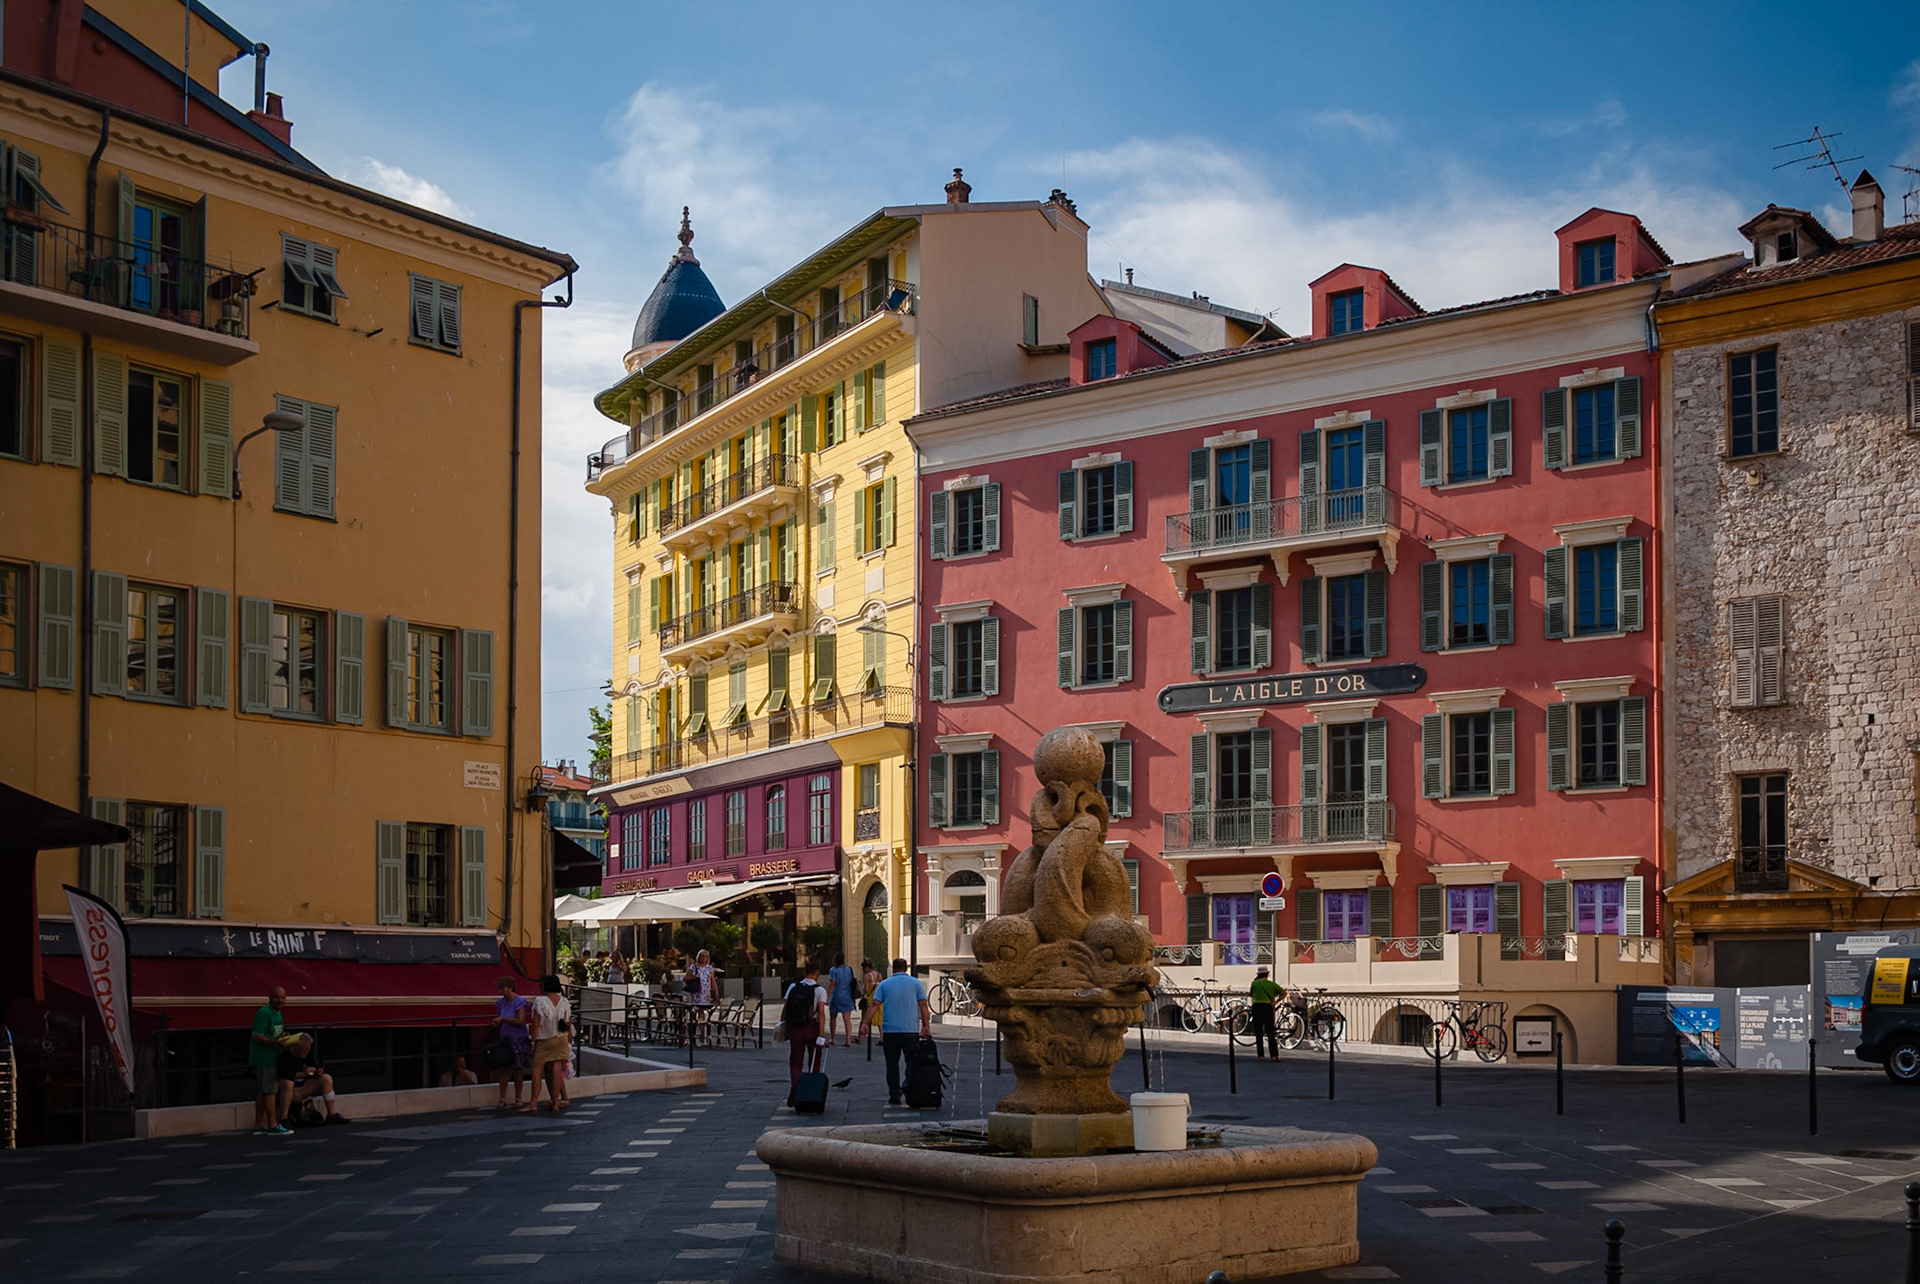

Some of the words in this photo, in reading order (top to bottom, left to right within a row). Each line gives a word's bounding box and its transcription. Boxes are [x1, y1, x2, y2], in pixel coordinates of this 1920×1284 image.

[1208, 679, 1303, 704] L'AIGLE
[1314, 674, 1367, 695] D'OR
[612, 877, 655, 892] RESTAURANT
[687, 868, 715, 884] GAGLIO
[750, 859, 797, 876] BRASSERIE
[249, 931, 263, 947] LE
